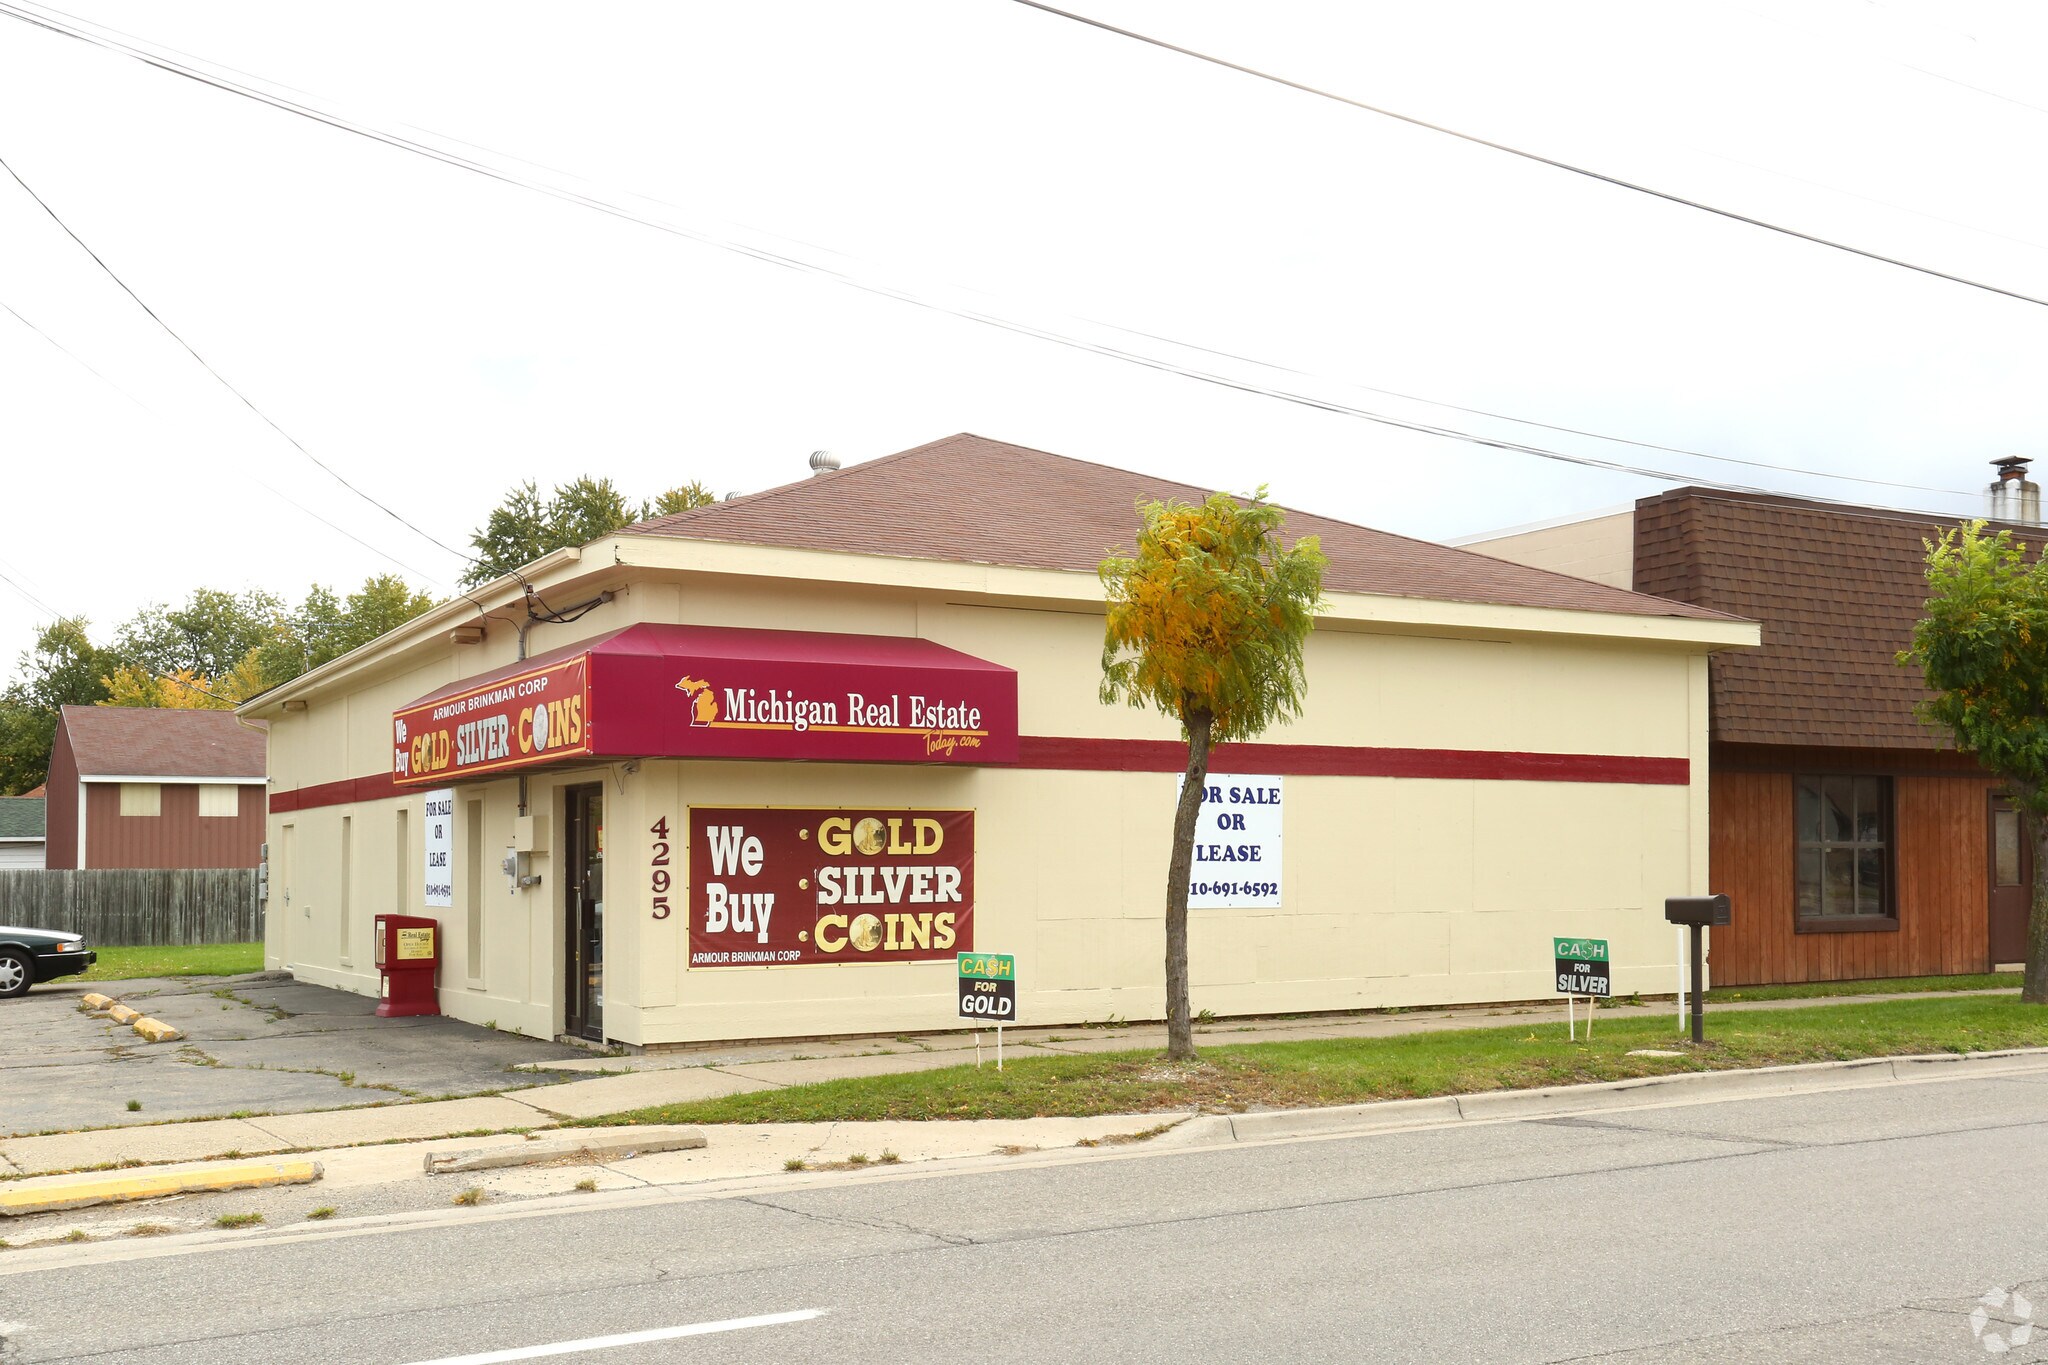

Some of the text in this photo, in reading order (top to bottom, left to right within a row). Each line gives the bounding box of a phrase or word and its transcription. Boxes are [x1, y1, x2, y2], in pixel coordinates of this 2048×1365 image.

[433, 677, 548, 721] ARMOUR BRINKMAN CORP
[724, 688, 980, 731] Michigan Real Estate
[395, 719, 407, 744] We
[411, 694, 581, 774] GOLD SILVER COINS
[395, 748, 409, 777] Buy
[1229, 787, 1281, 805] SALE
[426, 800, 451, 817] FOR SALE
[434, 824, 443, 840] OR
[1217, 813, 1246, 831] OR
[817, 817, 944, 856] GOLD
[429, 852, 447, 867] LEASE
[706, 826, 765, 877] We
[1196, 844, 1262, 862] LEASE
[817, 866, 962, 905] SILVER
[1188, 881, 1278, 897] 10-691-6592
[706, 883, 775, 944] Buy
[813, 912, 957, 953] COINS
[691, 950, 801, 964] ARMOUR BRINKMAN CORP
[1573, 963, 1591, 973] FOR
[974, 981, 997, 993] FOR
[1558, 974, 1608, 994] SILVER
[962, 994, 1012, 1016] GOLD
